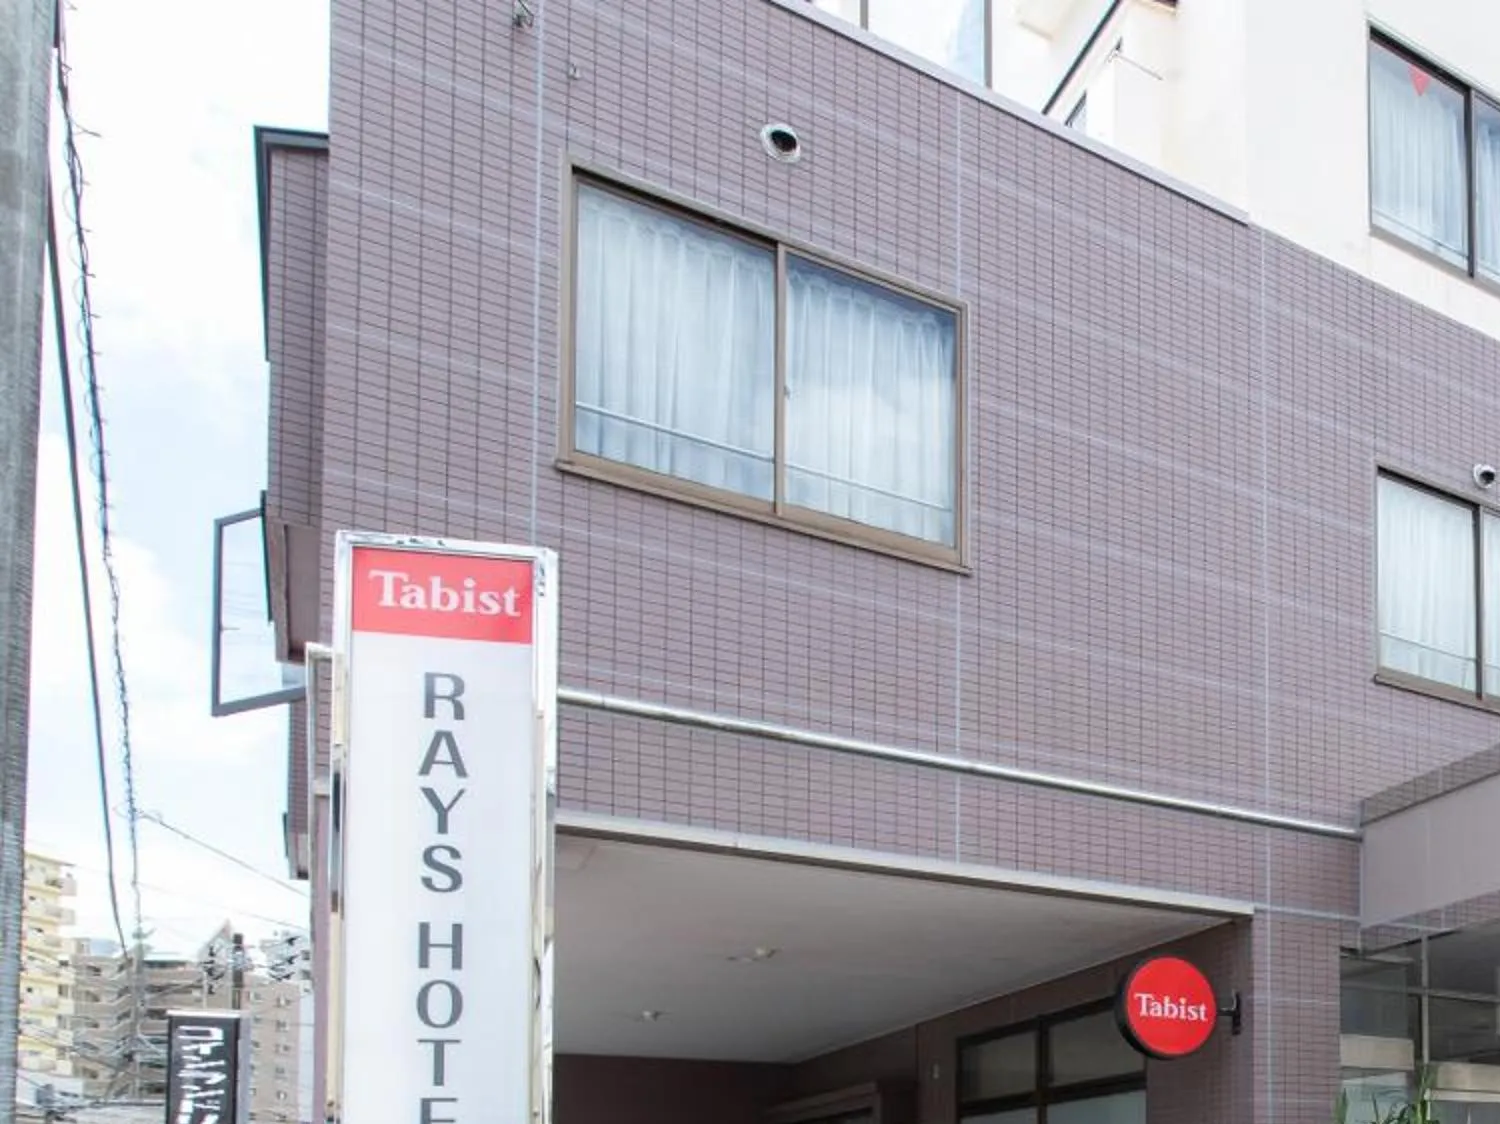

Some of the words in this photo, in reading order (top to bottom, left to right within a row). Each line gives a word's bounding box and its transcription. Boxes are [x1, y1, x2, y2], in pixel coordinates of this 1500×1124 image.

[368, 569, 521, 618] Tabist
[418, 671, 468, 893] RAYS
[1133, 992, 1208, 1022] Tabist
